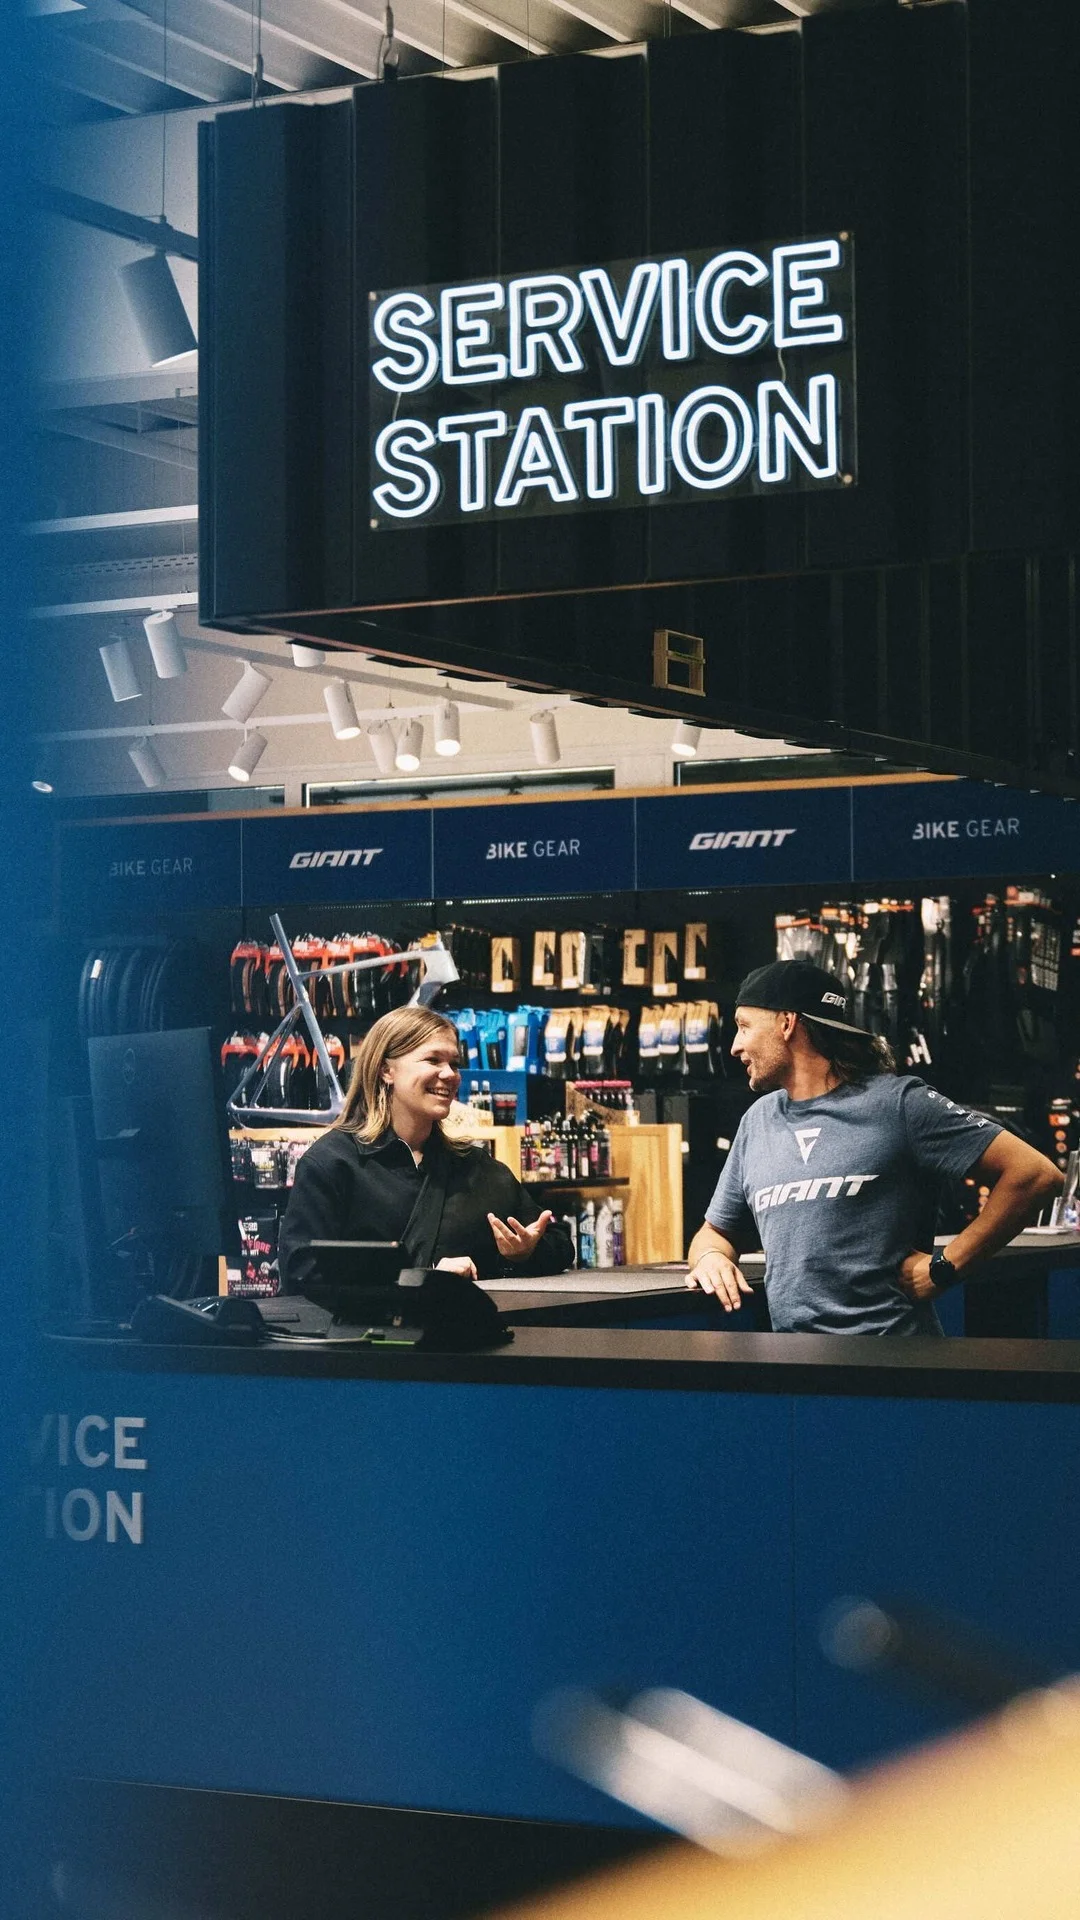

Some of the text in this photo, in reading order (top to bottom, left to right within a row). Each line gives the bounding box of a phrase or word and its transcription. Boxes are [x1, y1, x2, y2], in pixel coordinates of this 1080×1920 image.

[372, 239, 845, 393] SERVICE
[372, 374, 838, 518] STATION
[688, 828, 797, 851] GIANT
[912, 817, 1020, 840] BIKE GEAR
[288, 848, 384, 869] GIANT
[486, 838, 580, 860] BIKE GEAR
[109, 857, 193, 877] BIKE GEAR
[754, 1174, 880, 1213] GIANT
